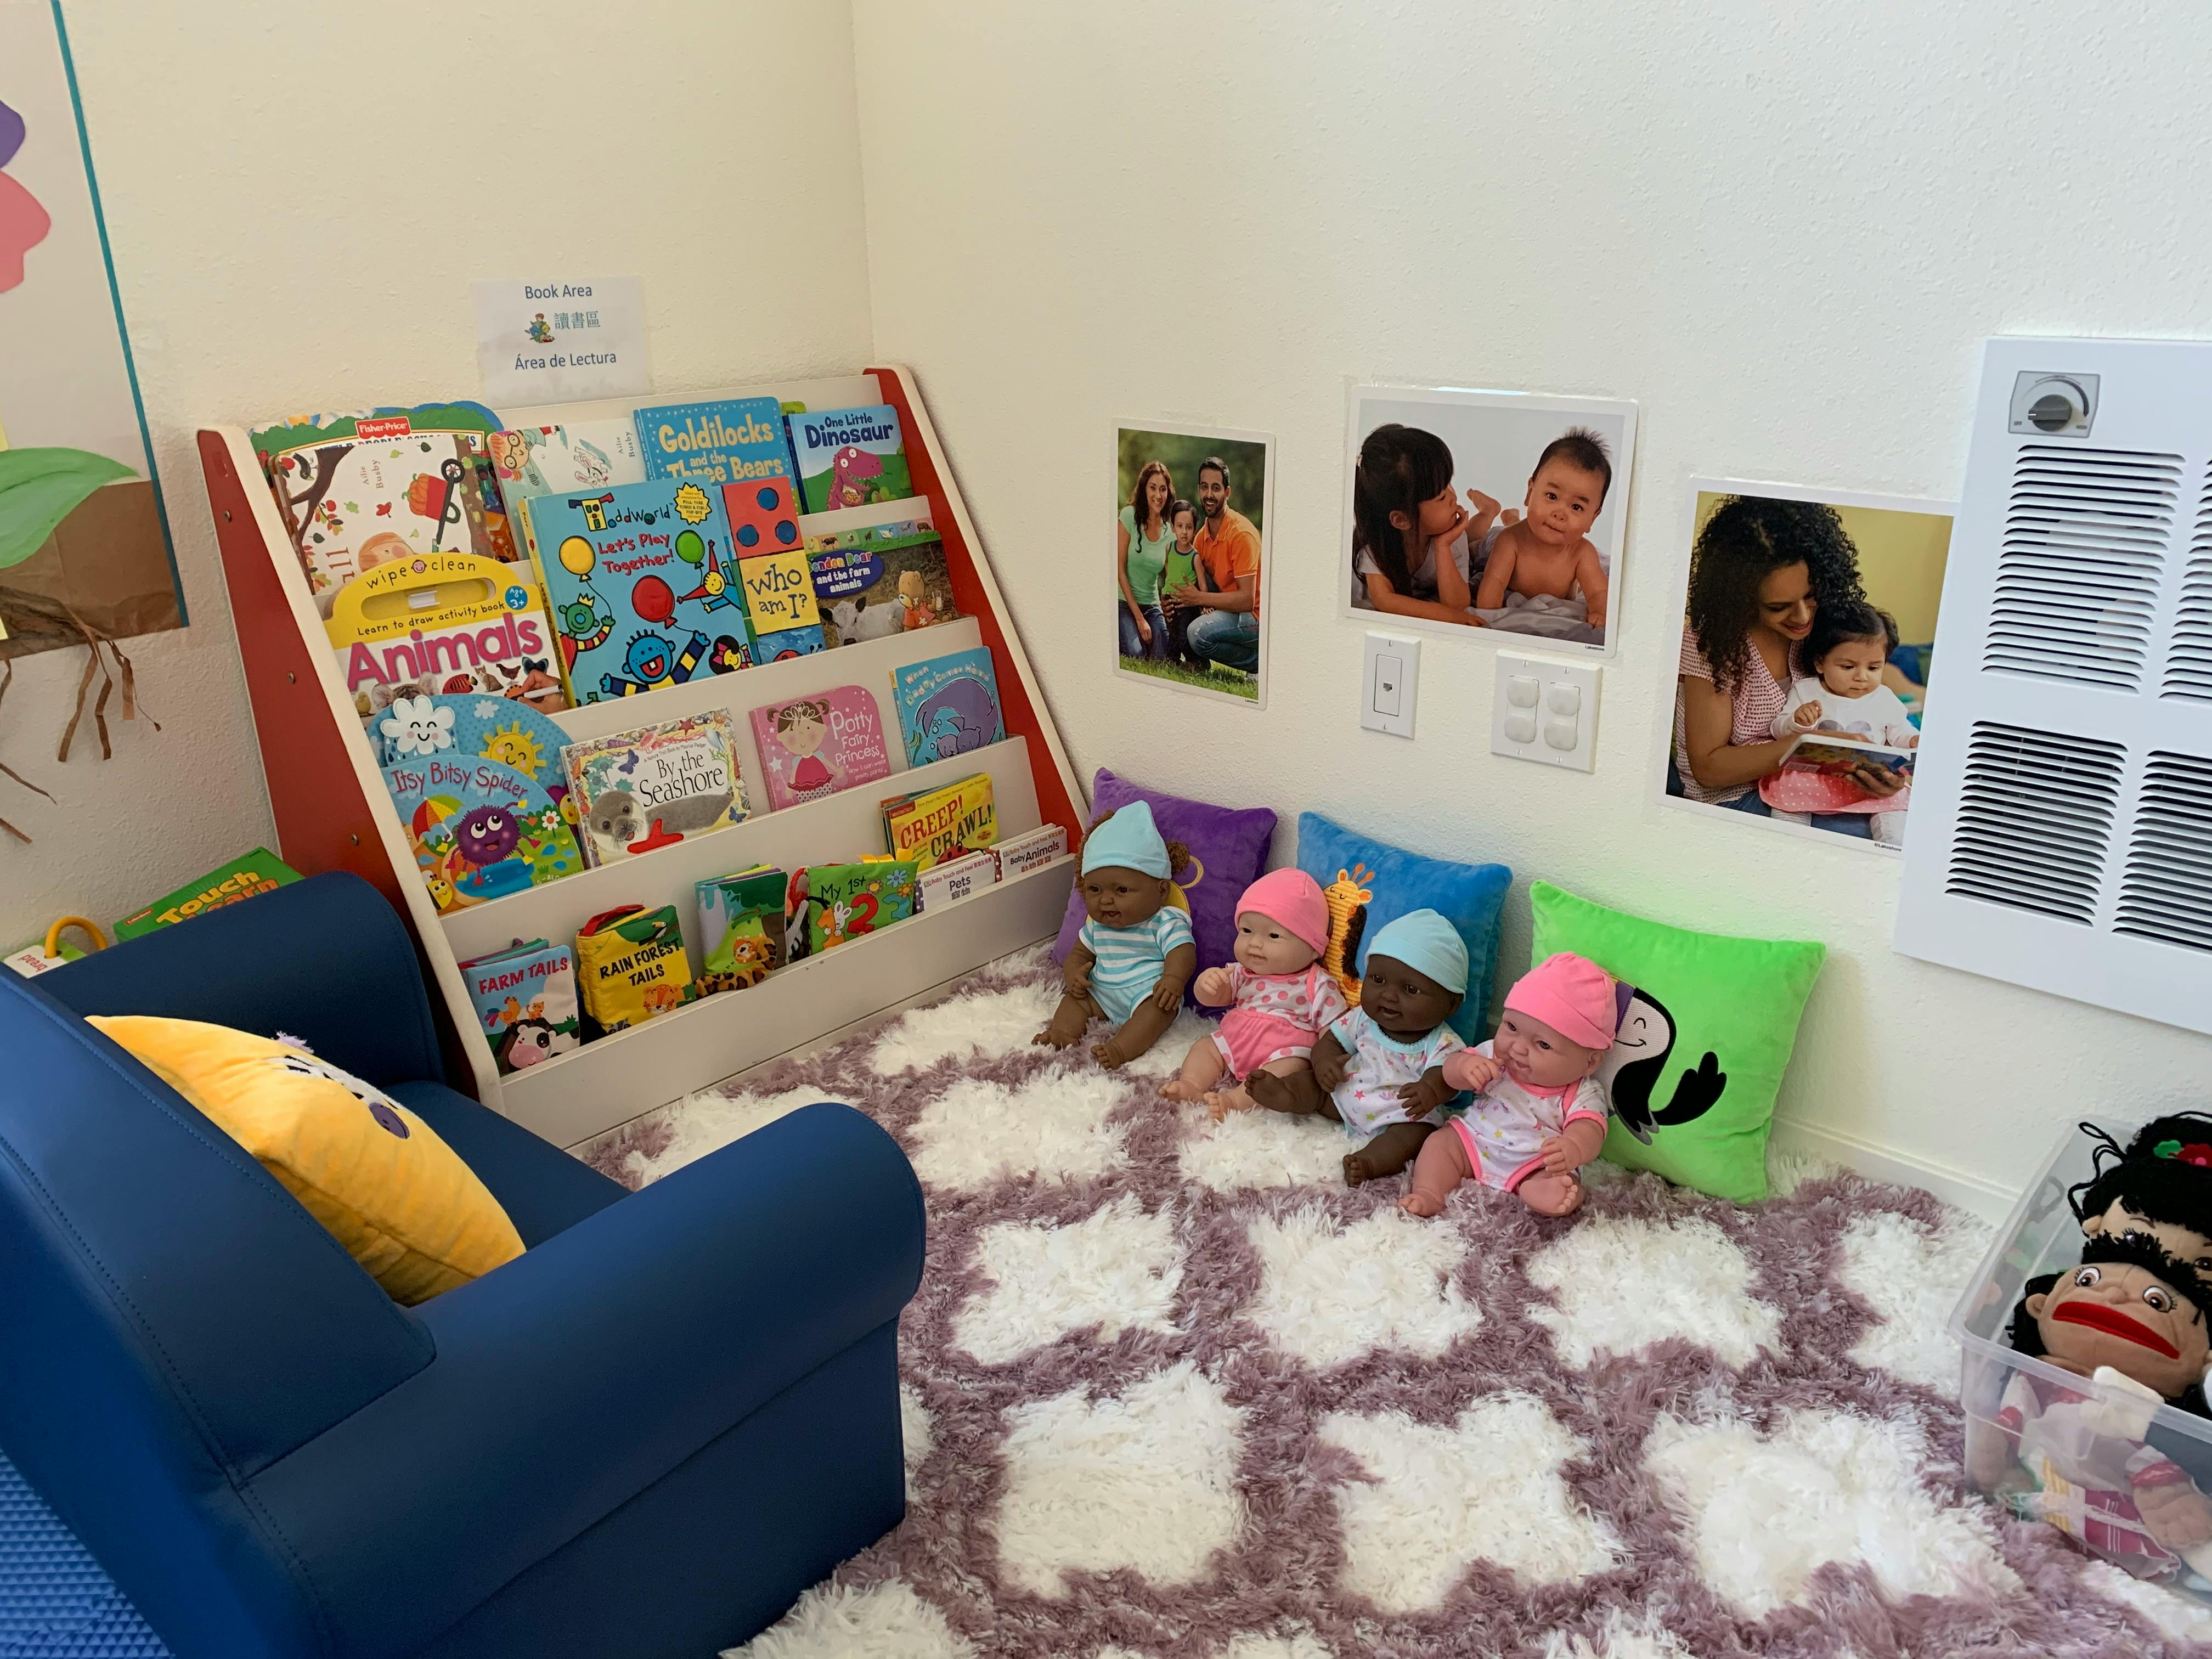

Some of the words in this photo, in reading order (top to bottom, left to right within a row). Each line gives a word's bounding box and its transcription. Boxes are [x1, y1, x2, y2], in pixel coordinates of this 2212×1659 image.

[525, 284, 558, 299] Book
[562, 284, 592, 297] Area
[553, 311, 601, 330] 讀書區
[515, 353, 546, 370] Área
[550, 354, 566, 367] de
[571, 352, 617, 366] Lectura
[659, 413, 774, 454] Goldilocks
[824, 416, 844, 427] One
[845, 414, 873, 426] Little
[625, 431, 635, 458] Busby
[804, 423, 894, 449] Dinosaur
[690, 452, 708, 466] and
[710, 450, 727, 465] the
[729, 456, 784, 480] Bears
[360, 466, 370, 484] Ailie
[371, 459, 384, 489] Busby
[597, 537, 636, 555] Let's
[638, 533, 670, 548] Play
[602, 548, 675, 576] Together!
[845, 550, 873, 567] Bear
[366, 566, 407, 590] wipe
[431, 556, 476, 572] clean
[816, 575, 833, 585] and
[833, 571, 848, 582] the
[848, 566, 871, 580] farm
[830, 579, 862, 593] animals
[510, 587, 523, 598] Age
[510, 599, 525, 608] 3+
[758, 599, 787, 614] am
[788, 592, 808, 619] I?
[358, 624, 388, 636] Learn
[393, 620, 403, 630] to
[408, 614, 433, 627] draw
[438, 606, 477, 620] activity
[481, 601, 505, 614] book
[347, 612, 543, 692] Animals
[830, 710, 873, 740] Potty
[841, 733, 871, 749] Fairy
[656, 759, 675, 783] By
[681, 751, 705, 771] the
[835, 744, 880, 766] Princess
[390, 769, 426, 795] Itsy
[430, 761, 472, 792] Bitsy
[475, 766, 528, 799] Spider
[639, 767, 725, 808] Seashore
[900, 794, 964, 850] CREEP!
[930, 803, 992, 858] CRAWL!
[821, 883, 842, 900] My
[848, 875, 867, 895] 1st
[931, 876, 943, 884] Baby
[943, 871, 955, 879] Touch
[949, 876, 971, 891] Pets
[155, 871, 261, 924] Touch
[185, 878, 280, 920] arn
[847, 893, 878, 934] 2
[16, 954, 48, 972] bread
[599, 958, 634, 980] RAIN
[636, 937, 680, 967] FOREST
[478, 968, 524, 995] FARM
[528, 957, 568, 978] TAILS
[628, 964, 665, 986] TAILS
